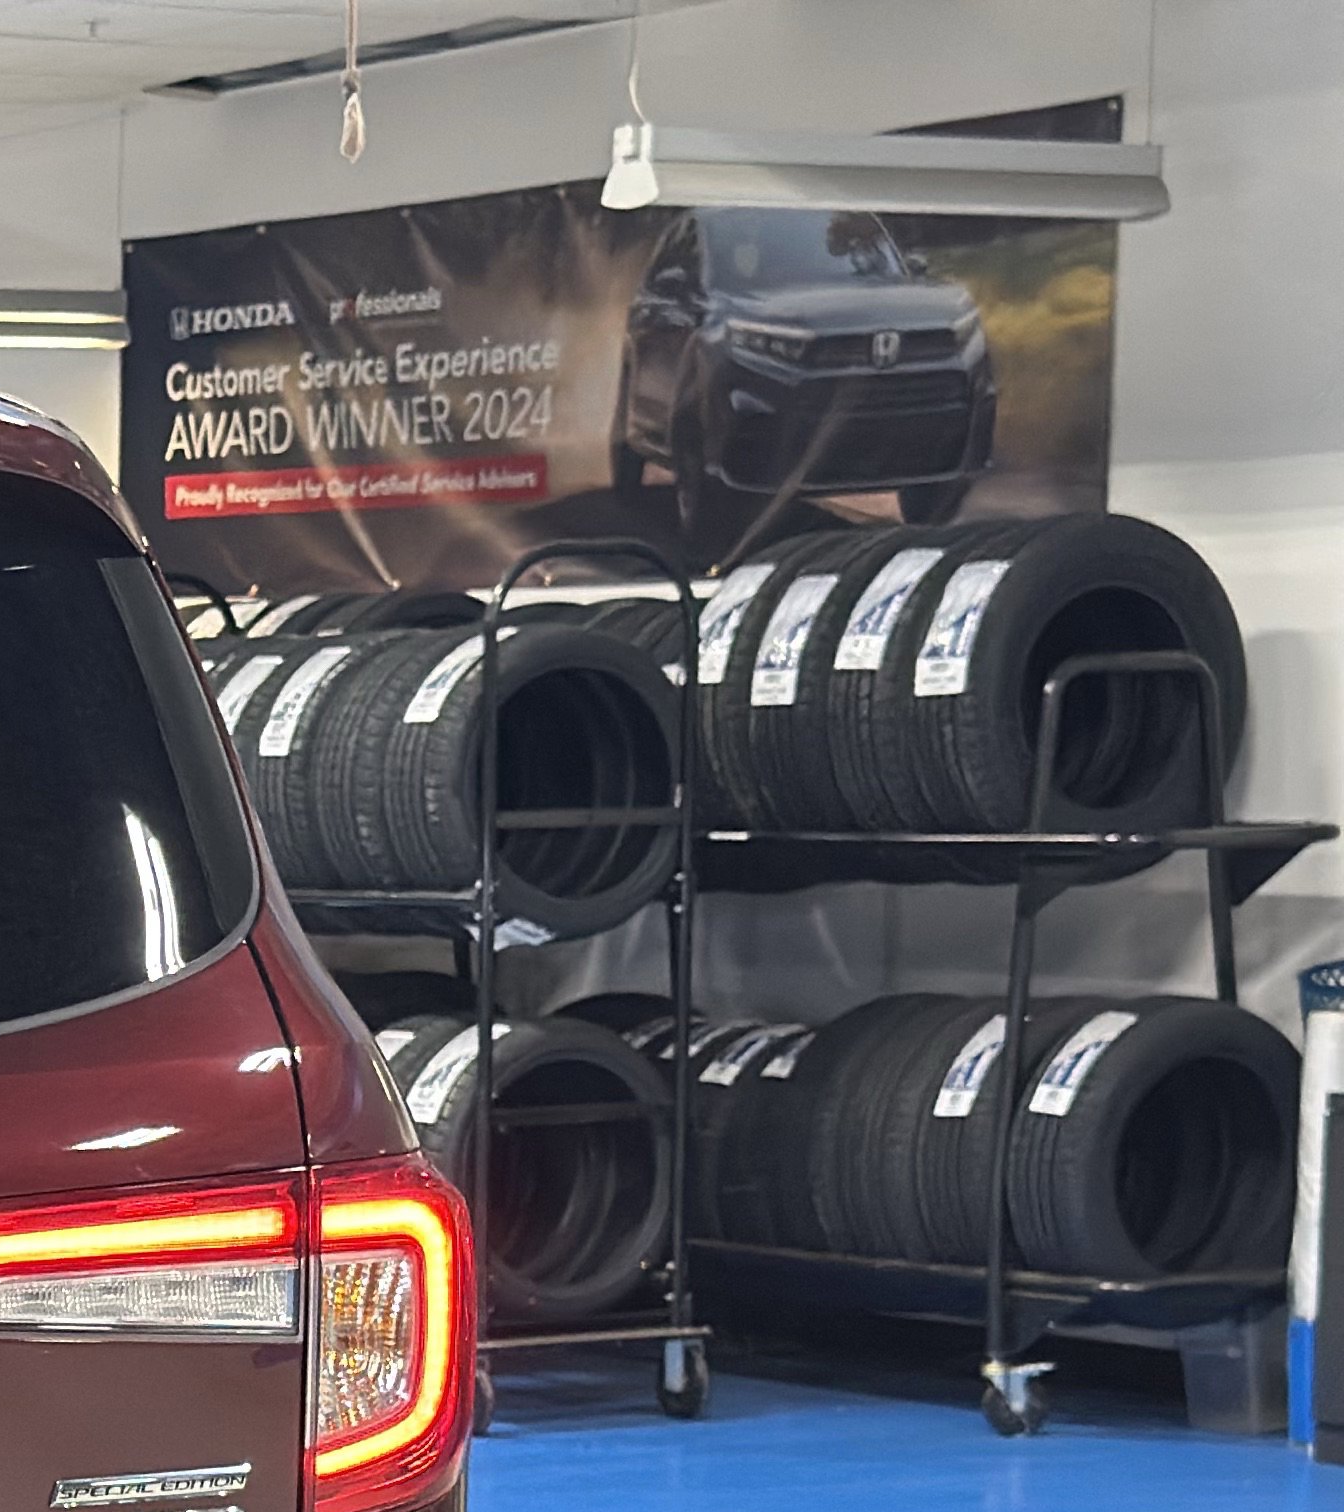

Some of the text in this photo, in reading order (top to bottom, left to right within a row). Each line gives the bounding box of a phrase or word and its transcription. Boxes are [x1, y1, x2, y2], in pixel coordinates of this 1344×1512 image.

[190, 301, 295, 336] HONDA
[165, 336, 561, 401] Customer Service Experience
[164, 386, 554, 462] AWARD WINNER 2024
[59, 1475, 247, 1500] SPECIAL EDITION
